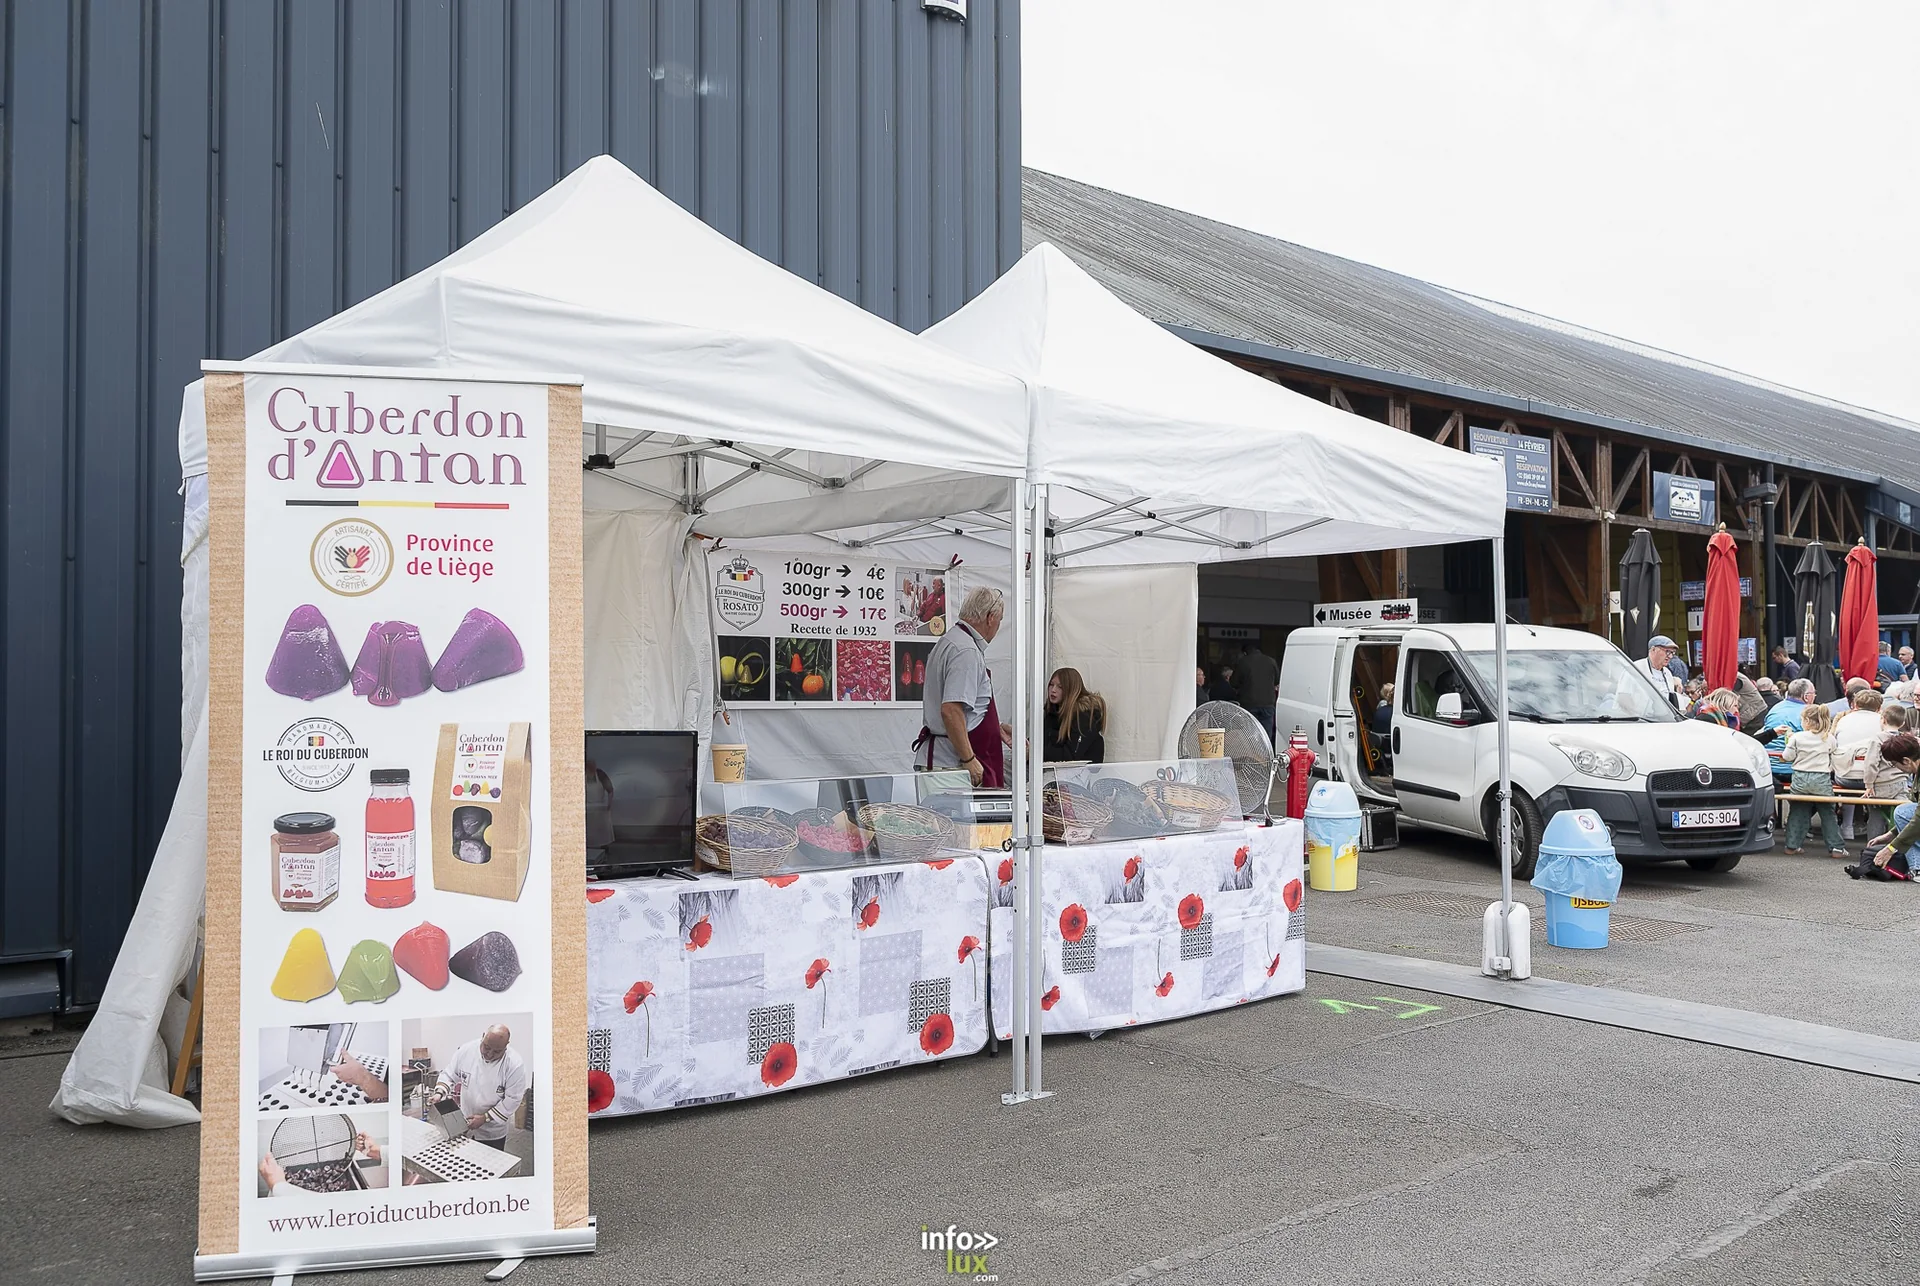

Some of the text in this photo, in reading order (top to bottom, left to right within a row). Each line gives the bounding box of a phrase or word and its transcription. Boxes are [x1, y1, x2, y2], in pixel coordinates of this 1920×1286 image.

[267, 386, 528, 439] Cuberdon
[1524, 440, 1546, 452] FÉVRIER
[334, 525, 374, 537] ARTISANAT
[406, 533, 495, 552] Province
[406, 557, 494, 583] de Liège
[784, 561, 885, 580] 100gr 4€
[335, 578, 369, 590] CERTIFIÉ
[782, 582, 885, 600] 300gr 10€
[723, 602, 759, 612] ROSATO
[780, 603, 887, 620] 500gr 17€
[1329, 607, 1372, 621] Musée
[1418, 609, 1436, 619] USEE
[790, 623, 878, 636] Recette de 1932
[262, 747, 369, 761] LE ROI DU CUBERDON
[268, 1194, 531, 1234] www.leroiducuberdon.be
